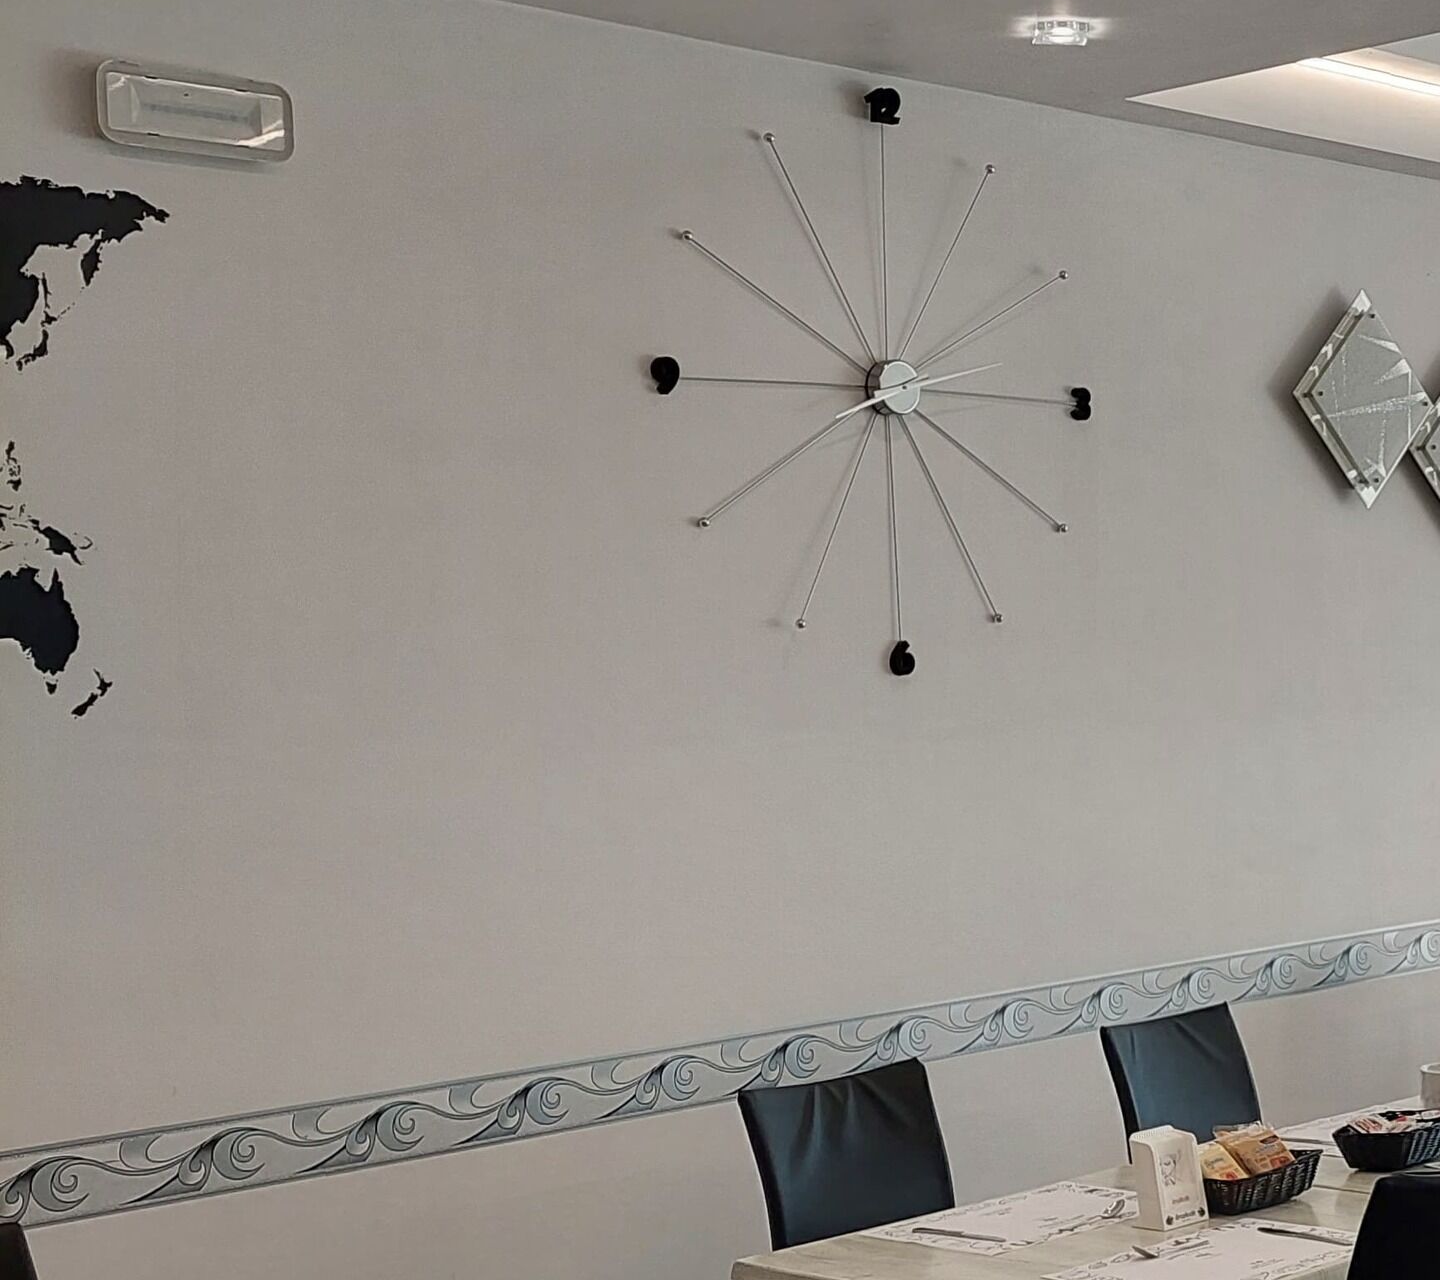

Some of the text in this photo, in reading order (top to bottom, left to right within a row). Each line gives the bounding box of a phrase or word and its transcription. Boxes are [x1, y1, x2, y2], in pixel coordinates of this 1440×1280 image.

[651, 356, 680, 395] 9
[1070, 387, 1091, 421] 3
[889, 640, 915, 676] 6
